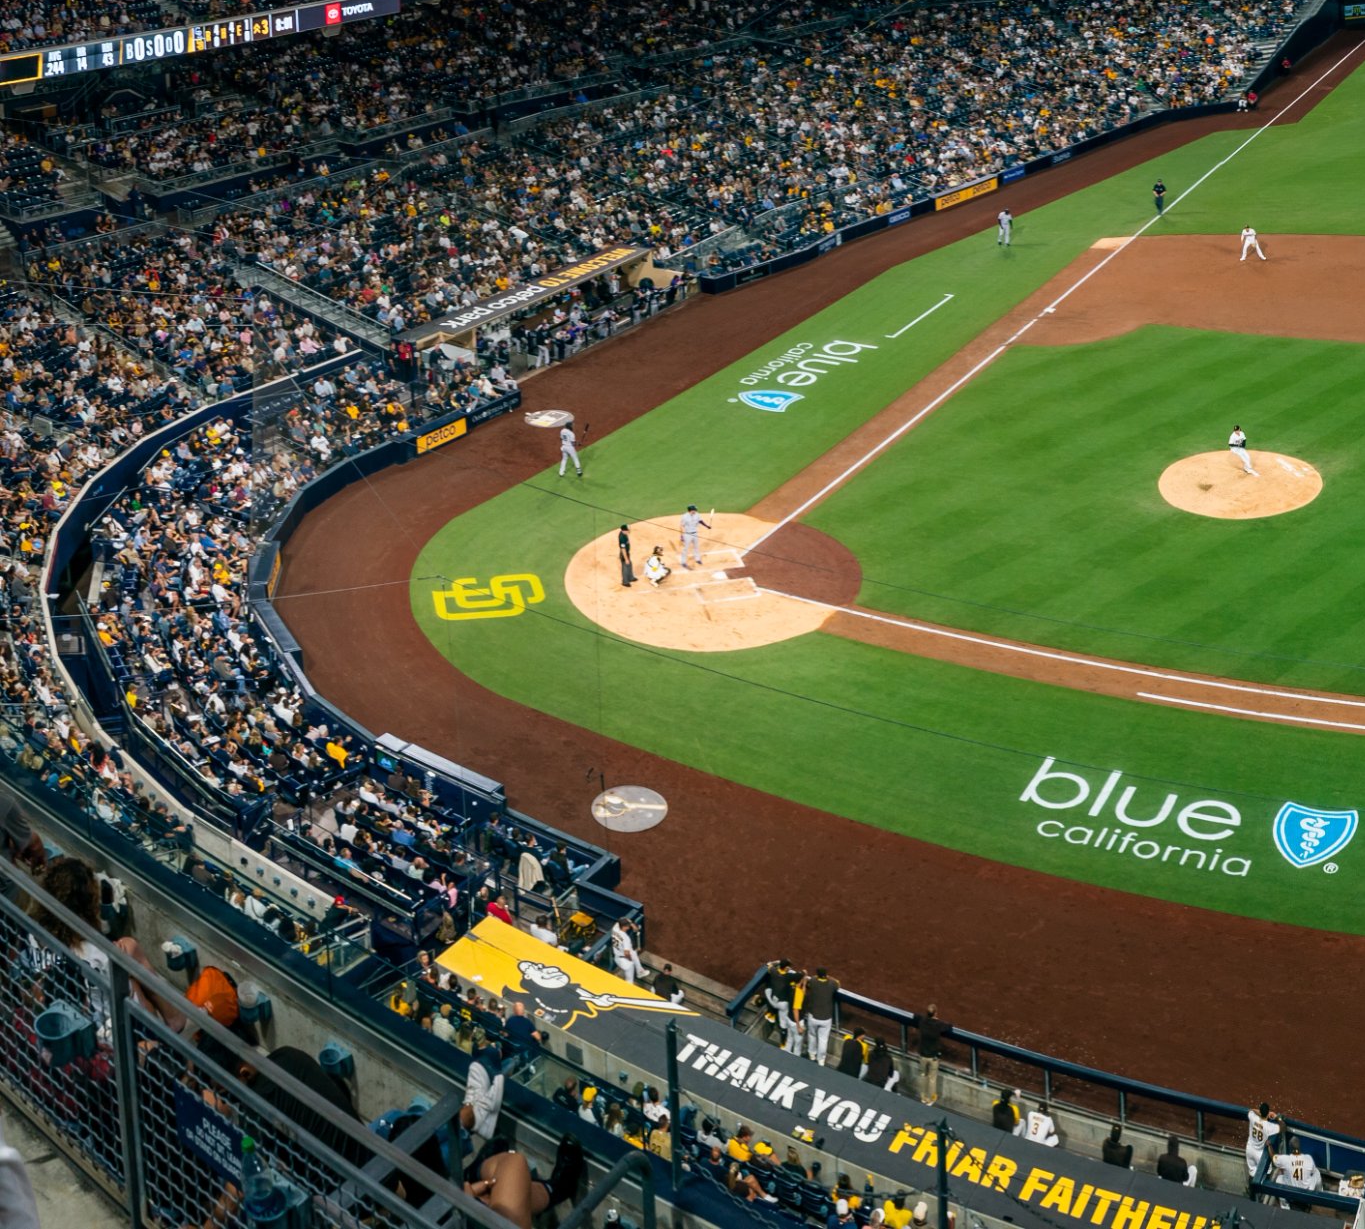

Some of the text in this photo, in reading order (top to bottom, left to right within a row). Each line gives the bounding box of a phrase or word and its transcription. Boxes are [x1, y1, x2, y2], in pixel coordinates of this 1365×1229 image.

[342, 3, 374, 16] TOYOTA
[261, 19, 269, 36] 3
[941, 193, 961, 207] petco
[440, 247, 637, 329] WELCOME TO petco park
[739, 342, 814, 386] california
[777, 340, 879, 386] blue
[425, 424, 456, 447] petco
[1019, 756, 1243, 842] blue
[1036, 818, 1253, 878] california
[674, 1033, 1018, 1192] THANK YOU FRIAR
[202, 1117, 232, 1151] PLEASE
[1031, 1123, 1040, 1135] 3
[1252, 1129, 1263, 1141] 28
[1293, 1168, 1304, 1180] 41
